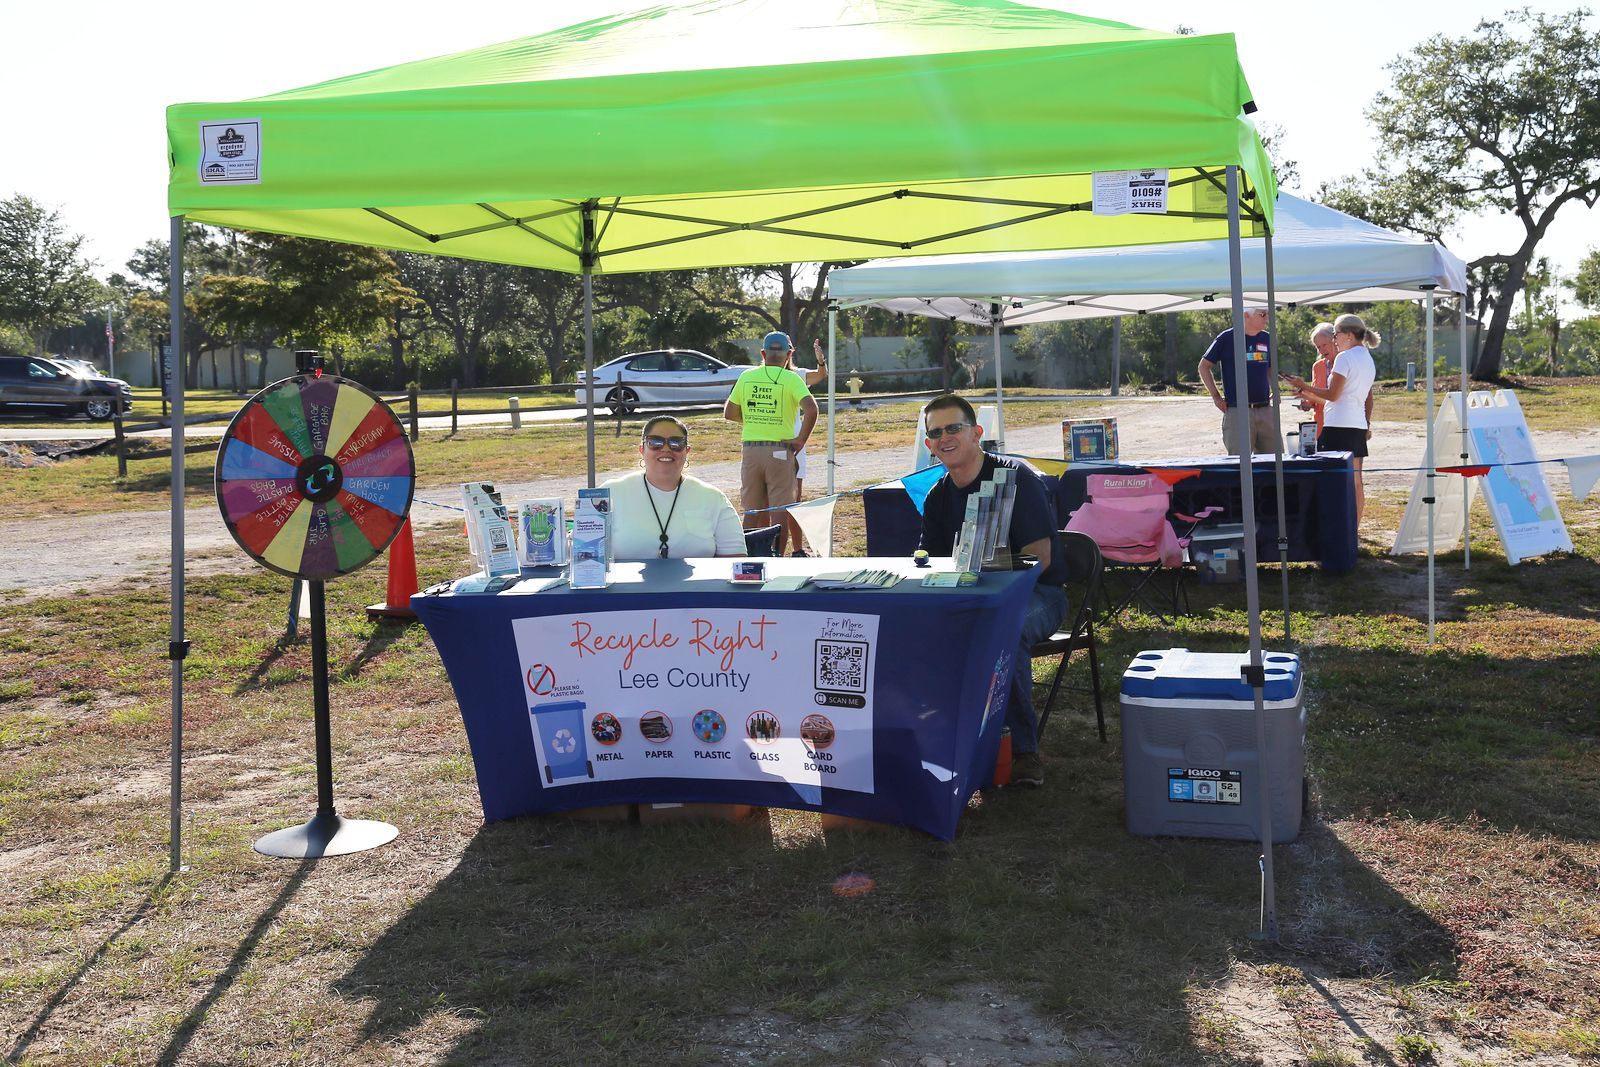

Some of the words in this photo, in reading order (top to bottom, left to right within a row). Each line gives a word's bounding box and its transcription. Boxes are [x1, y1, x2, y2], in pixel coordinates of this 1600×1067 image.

[1131, 188, 1162, 197] #6010
[267, 434, 299, 463] TISSUE
[337, 426, 386, 465] STYROFOAM
[249, 480, 277, 492] BAGS
[349, 479, 390, 491] GARDEN
[1104, 479, 1125, 487] Rural
[1127, 479, 1146, 488] King
[256, 485, 293, 503] PLASTIC
[346, 493, 366, 513] MILK
[274, 496, 301, 527] WATER
[349, 508, 365, 525] JUG
[316, 509, 328, 541] GLASS
[307, 525, 319, 546] JAR
[826, 617, 839, 629] For
[841, 618, 864, 630] More
[570, 618, 679, 670] Recycle
[689, 614, 778, 671] Right,
[619, 669, 659, 689] Lee
[667, 667, 751, 692] County
[550, 690, 569, 698] PLASTIC
[828, 696, 847, 705] SCAN
[848, 697, 859, 705] ME
[596, 752, 624, 762] METAL
[645, 750, 674, 759] PAPER
[694, 750, 732, 760] PLASTIC
[749, 752, 780, 761] GLASS
[806, 750, 833, 761] CARD
[804, 762, 837, 774] BOARD
[1187, 769, 1221, 777] IGLOO
[1173, 783, 1182, 794] 5
